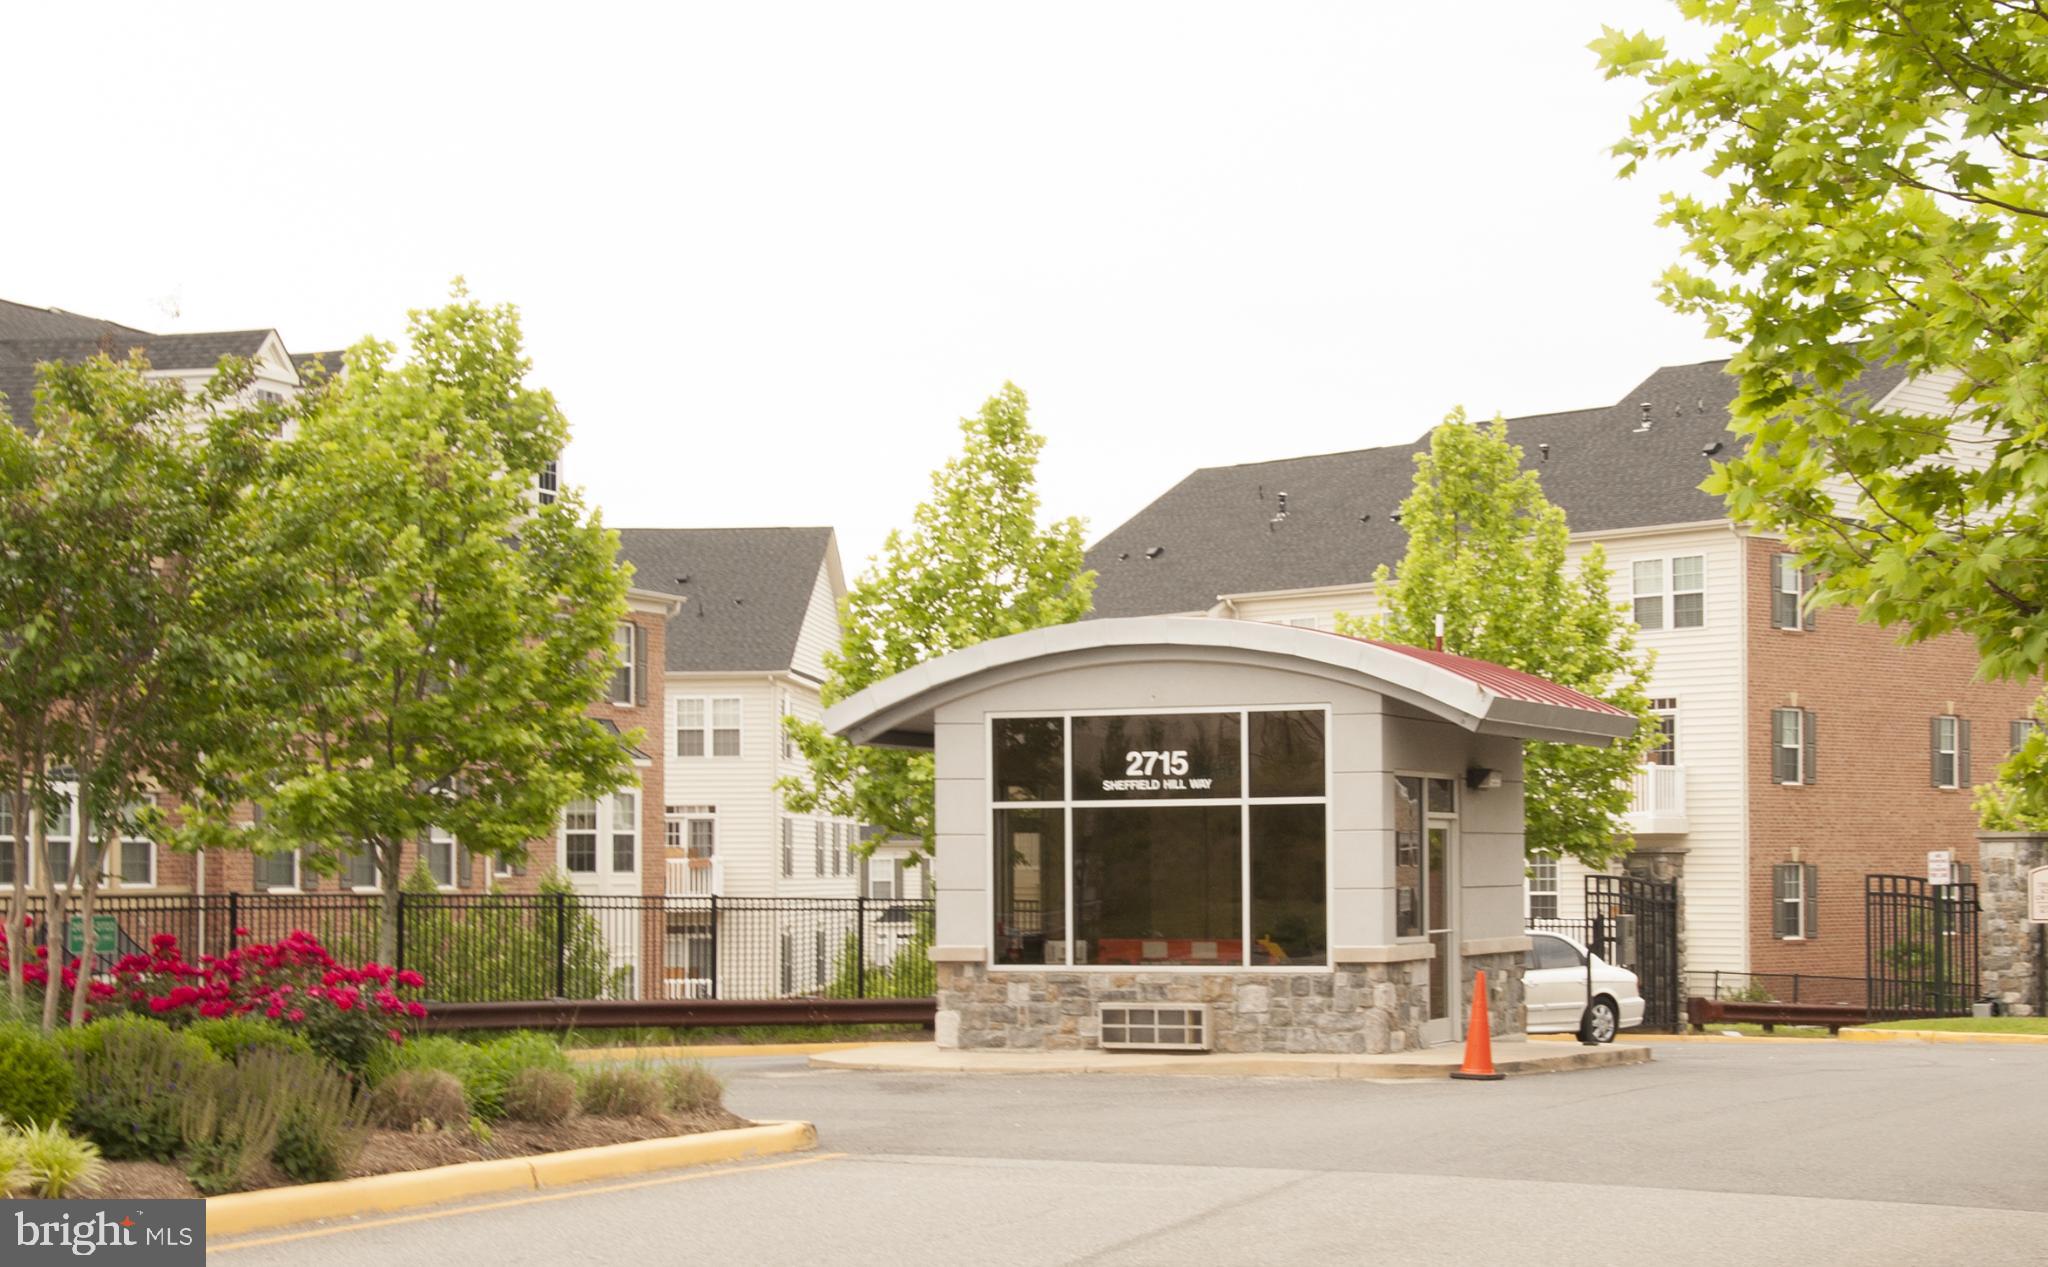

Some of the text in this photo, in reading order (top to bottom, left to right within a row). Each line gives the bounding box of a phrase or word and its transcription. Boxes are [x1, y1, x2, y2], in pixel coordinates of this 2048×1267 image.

[1125, 750, 1189, 776] 2715
[1102, 778, 1212, 791] SHEFFIELD HILL WAY
